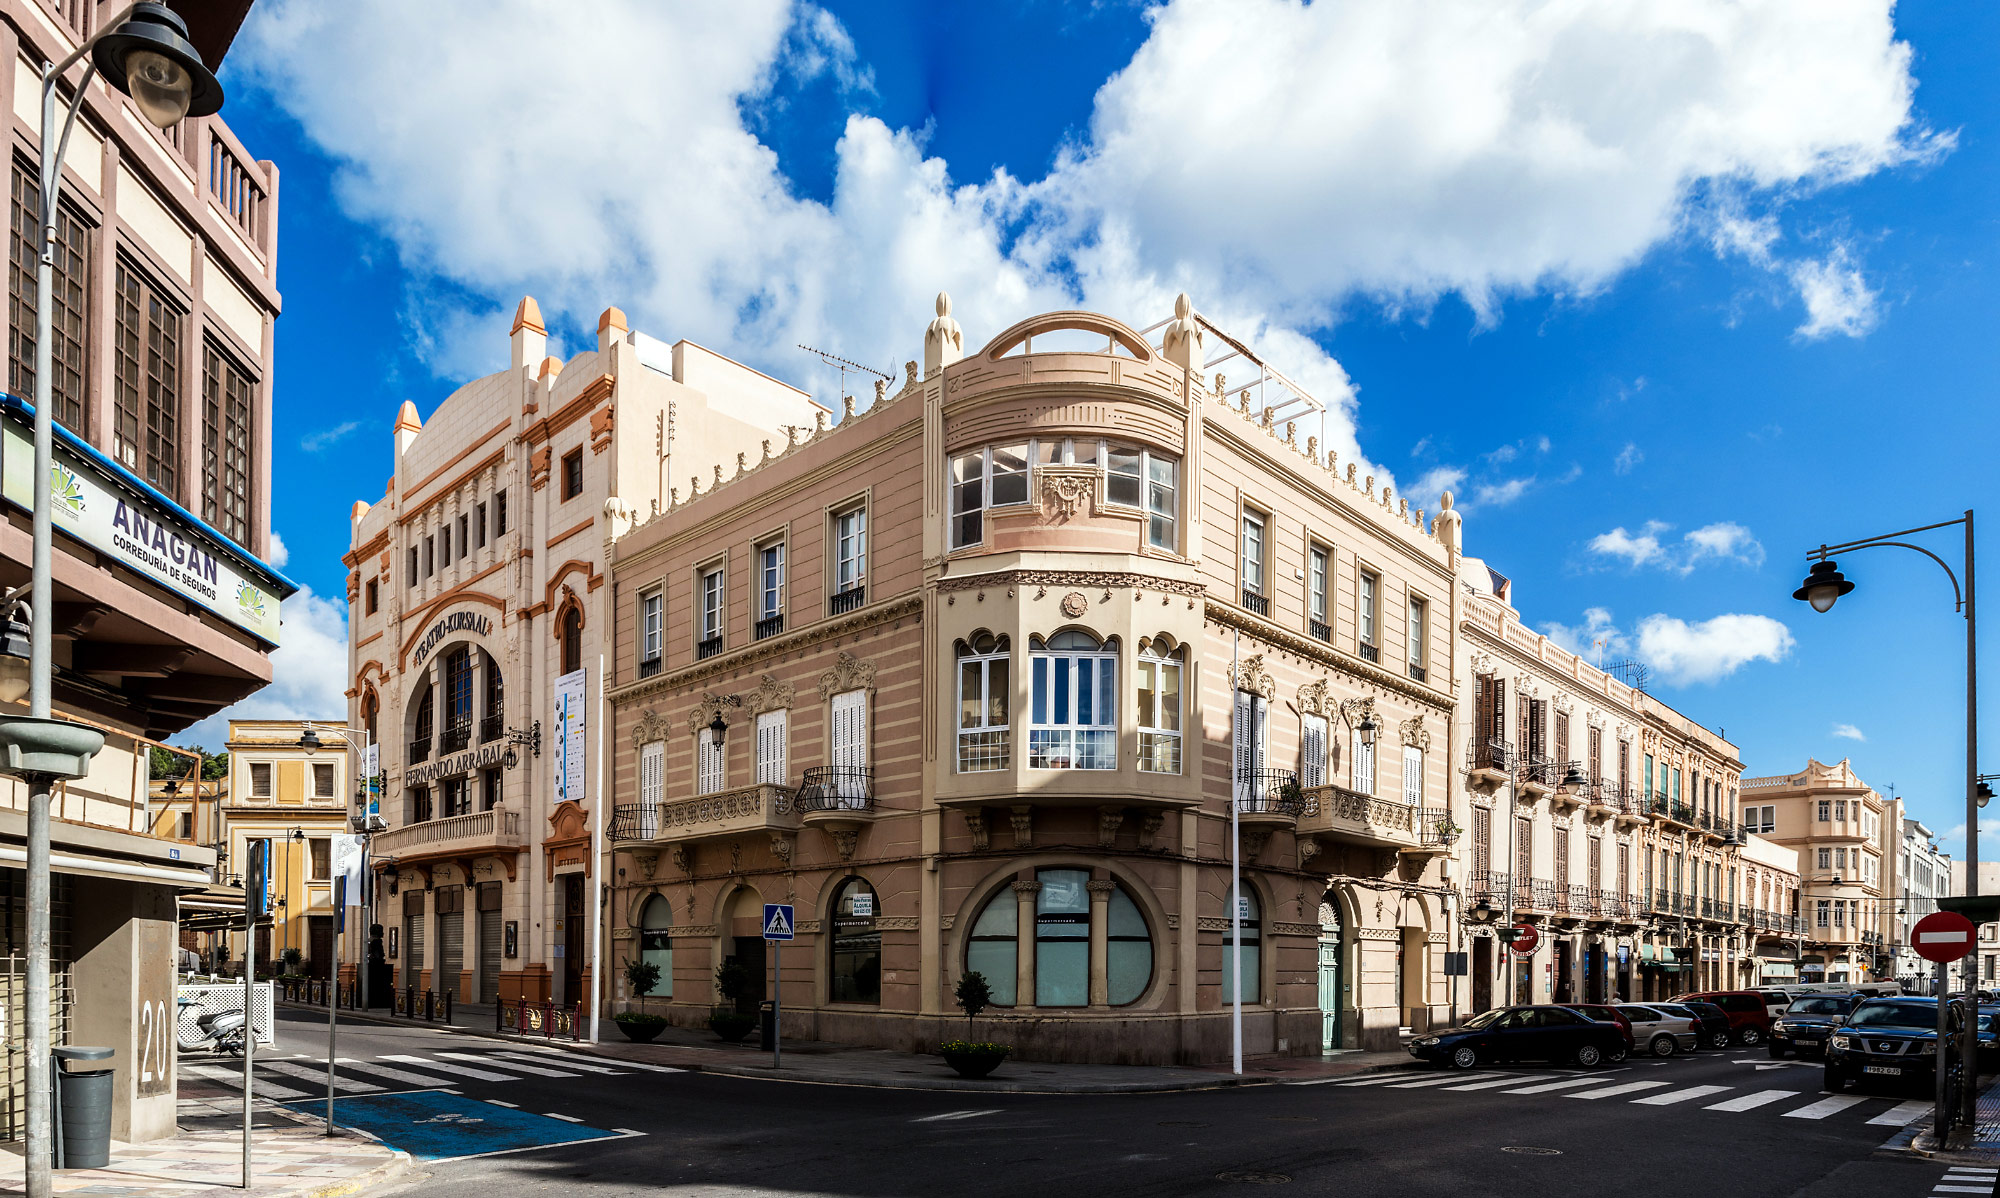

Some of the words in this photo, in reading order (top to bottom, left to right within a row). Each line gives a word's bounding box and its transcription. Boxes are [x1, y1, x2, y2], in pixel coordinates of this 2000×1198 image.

[113, 497, 218, 586] ANAGAN
[113, 533, 168, 575] CORREDURÍA
[169, 566, 181, 581] DE
[181, 572, 217, 601] SEGUROS
[415, 611, 488, 666] TEATRO-KURSAAL
[405, 757, 454, 786] FERNANDO
[455, 744, 504, 771] ARRABAL
[142, 999, 167, 1082] 20
